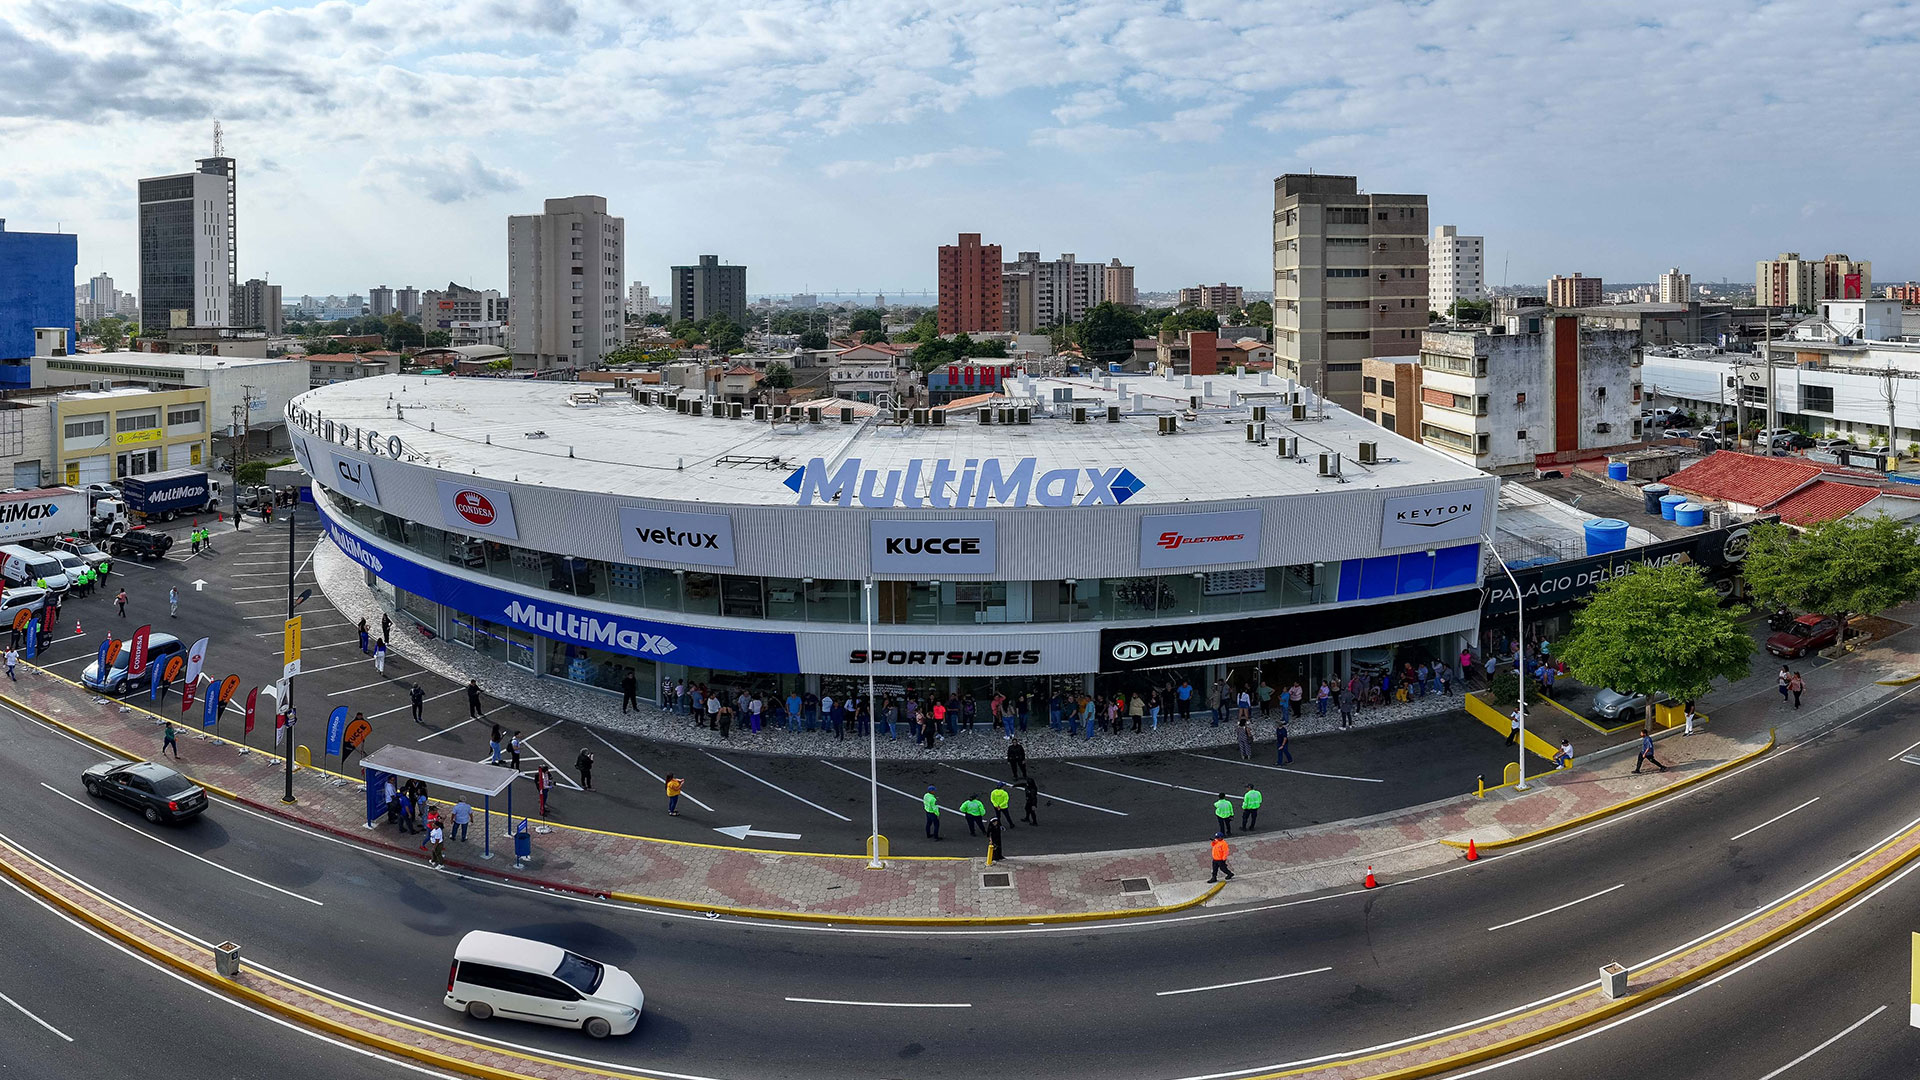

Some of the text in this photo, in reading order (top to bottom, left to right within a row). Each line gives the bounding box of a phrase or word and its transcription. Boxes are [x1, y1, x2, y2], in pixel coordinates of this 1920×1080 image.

[868, 370, 896, 379] HOTEL
[338, 460, 370, 497] CLX
[798, 457, 1126, 509] MultiMax
[151, 484, 200, 503] MultiMax
[457, 503, 493, 518] CONDESA
[1397, 503, 1472, 520] KEYTON
[330, 523, 377, 569] MultiMax
[635, 526, 720, 550] vetrux
[886, 537, 981, 555] KUCCE
[1156, 531, 1245, 549] SJ ELECTRONICS
[1490, 552, 1681, 603] PALACIO DEL BLMER
[511, 600, 662, 655] MultiMax
[133, 634, 144, 670] CONDESA
[1150, 637, 1220, 656] GWM
[849, 649, 1041, 666] SPORTSHOES
